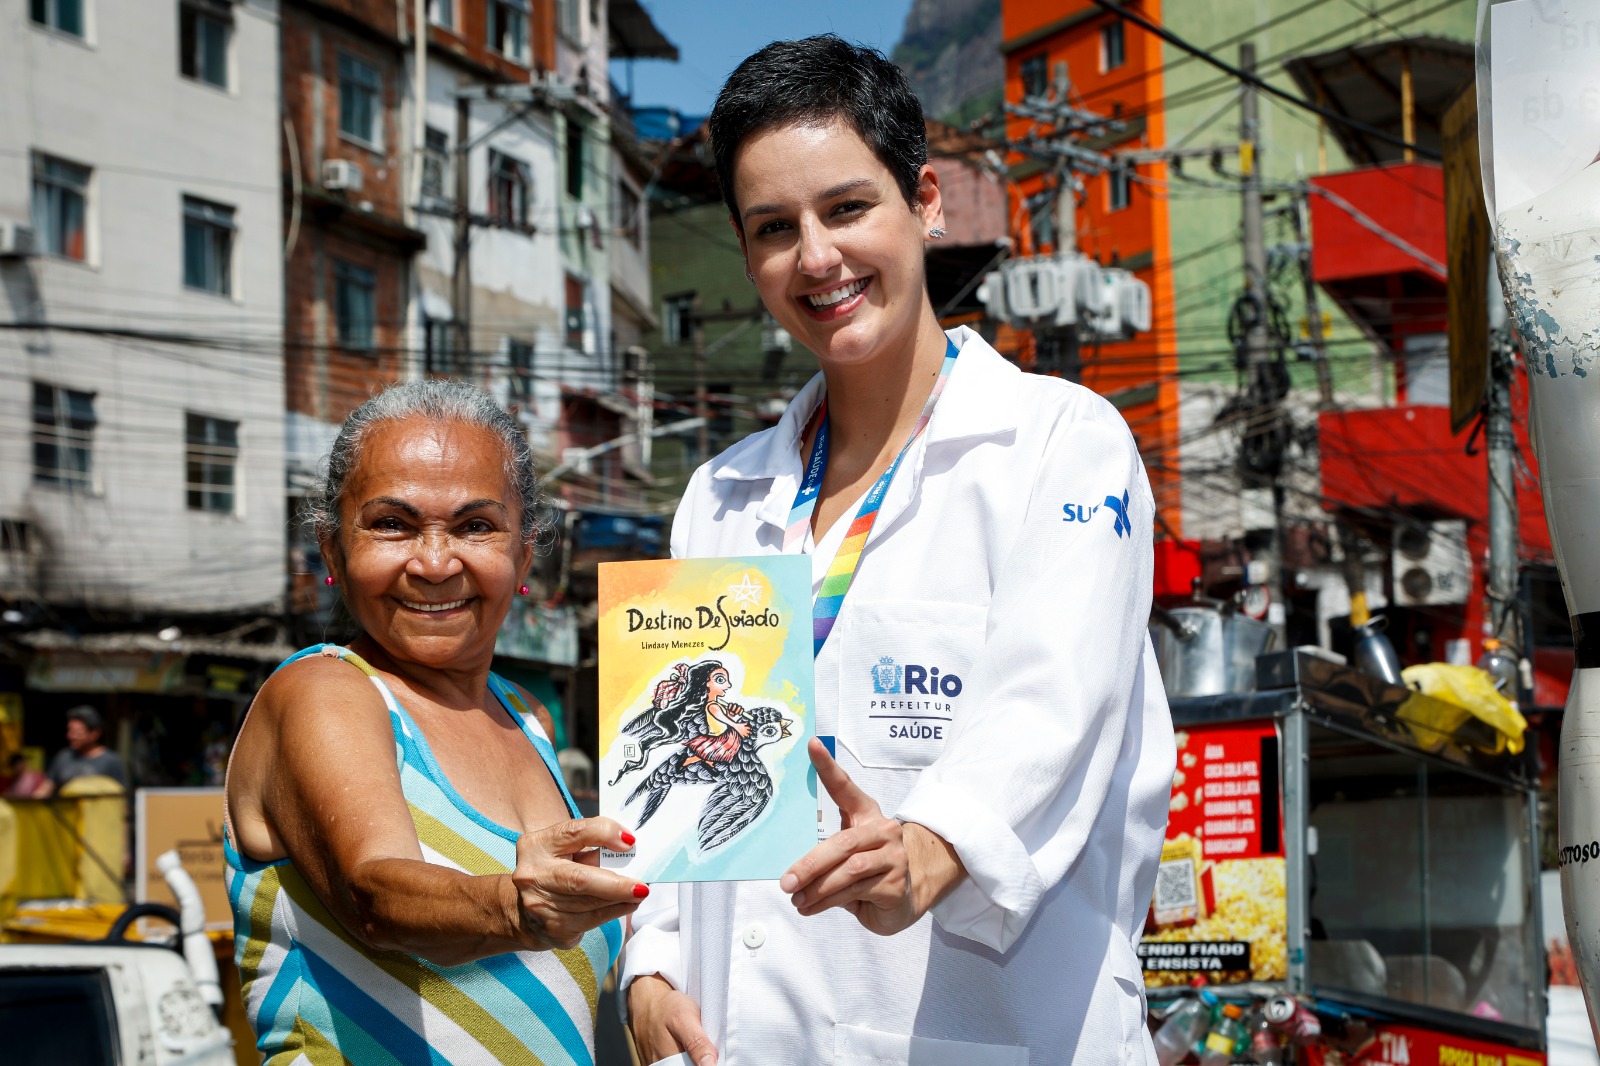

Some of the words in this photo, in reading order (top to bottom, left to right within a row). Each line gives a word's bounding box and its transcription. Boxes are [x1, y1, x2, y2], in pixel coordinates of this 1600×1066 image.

[807, 450, 824, 480] SAÚDE
[625, 607, 693, 633] Destino
[671, 640, 705, 649] Menezes
[904, 664, 963, 698] Rio
[870, 700, 952, 712] PREFEITUR
[889, 721, 943, 740] SAÚDE
[1138, 943, 1187, 956] ENDO
[1190, 943, 1245, 956] FIADO
[1147, 957, 1223, 970] ENSISTA
[1379, 1032, 1410, 1065] TIA
